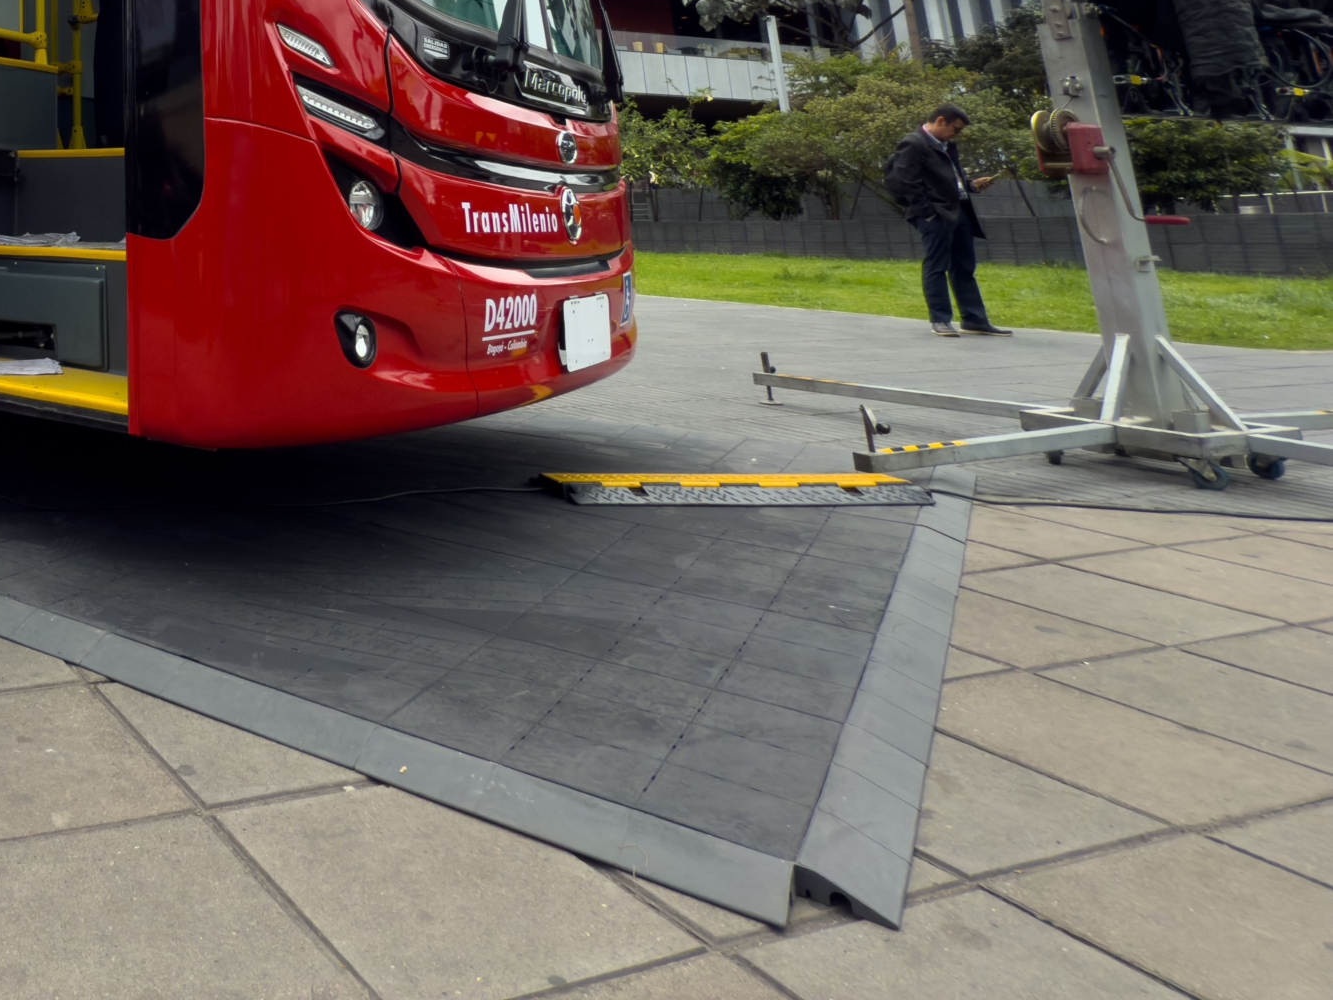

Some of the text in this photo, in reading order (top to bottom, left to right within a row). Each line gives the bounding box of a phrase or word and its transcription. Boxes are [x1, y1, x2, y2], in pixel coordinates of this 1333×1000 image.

[423, 37, 448, 48] SALIDAS
[524, 67, 587, 105] Marcopolo
[461, 202, 559, 233] TransMilenio
[484, 293, 538, 333] D42000
